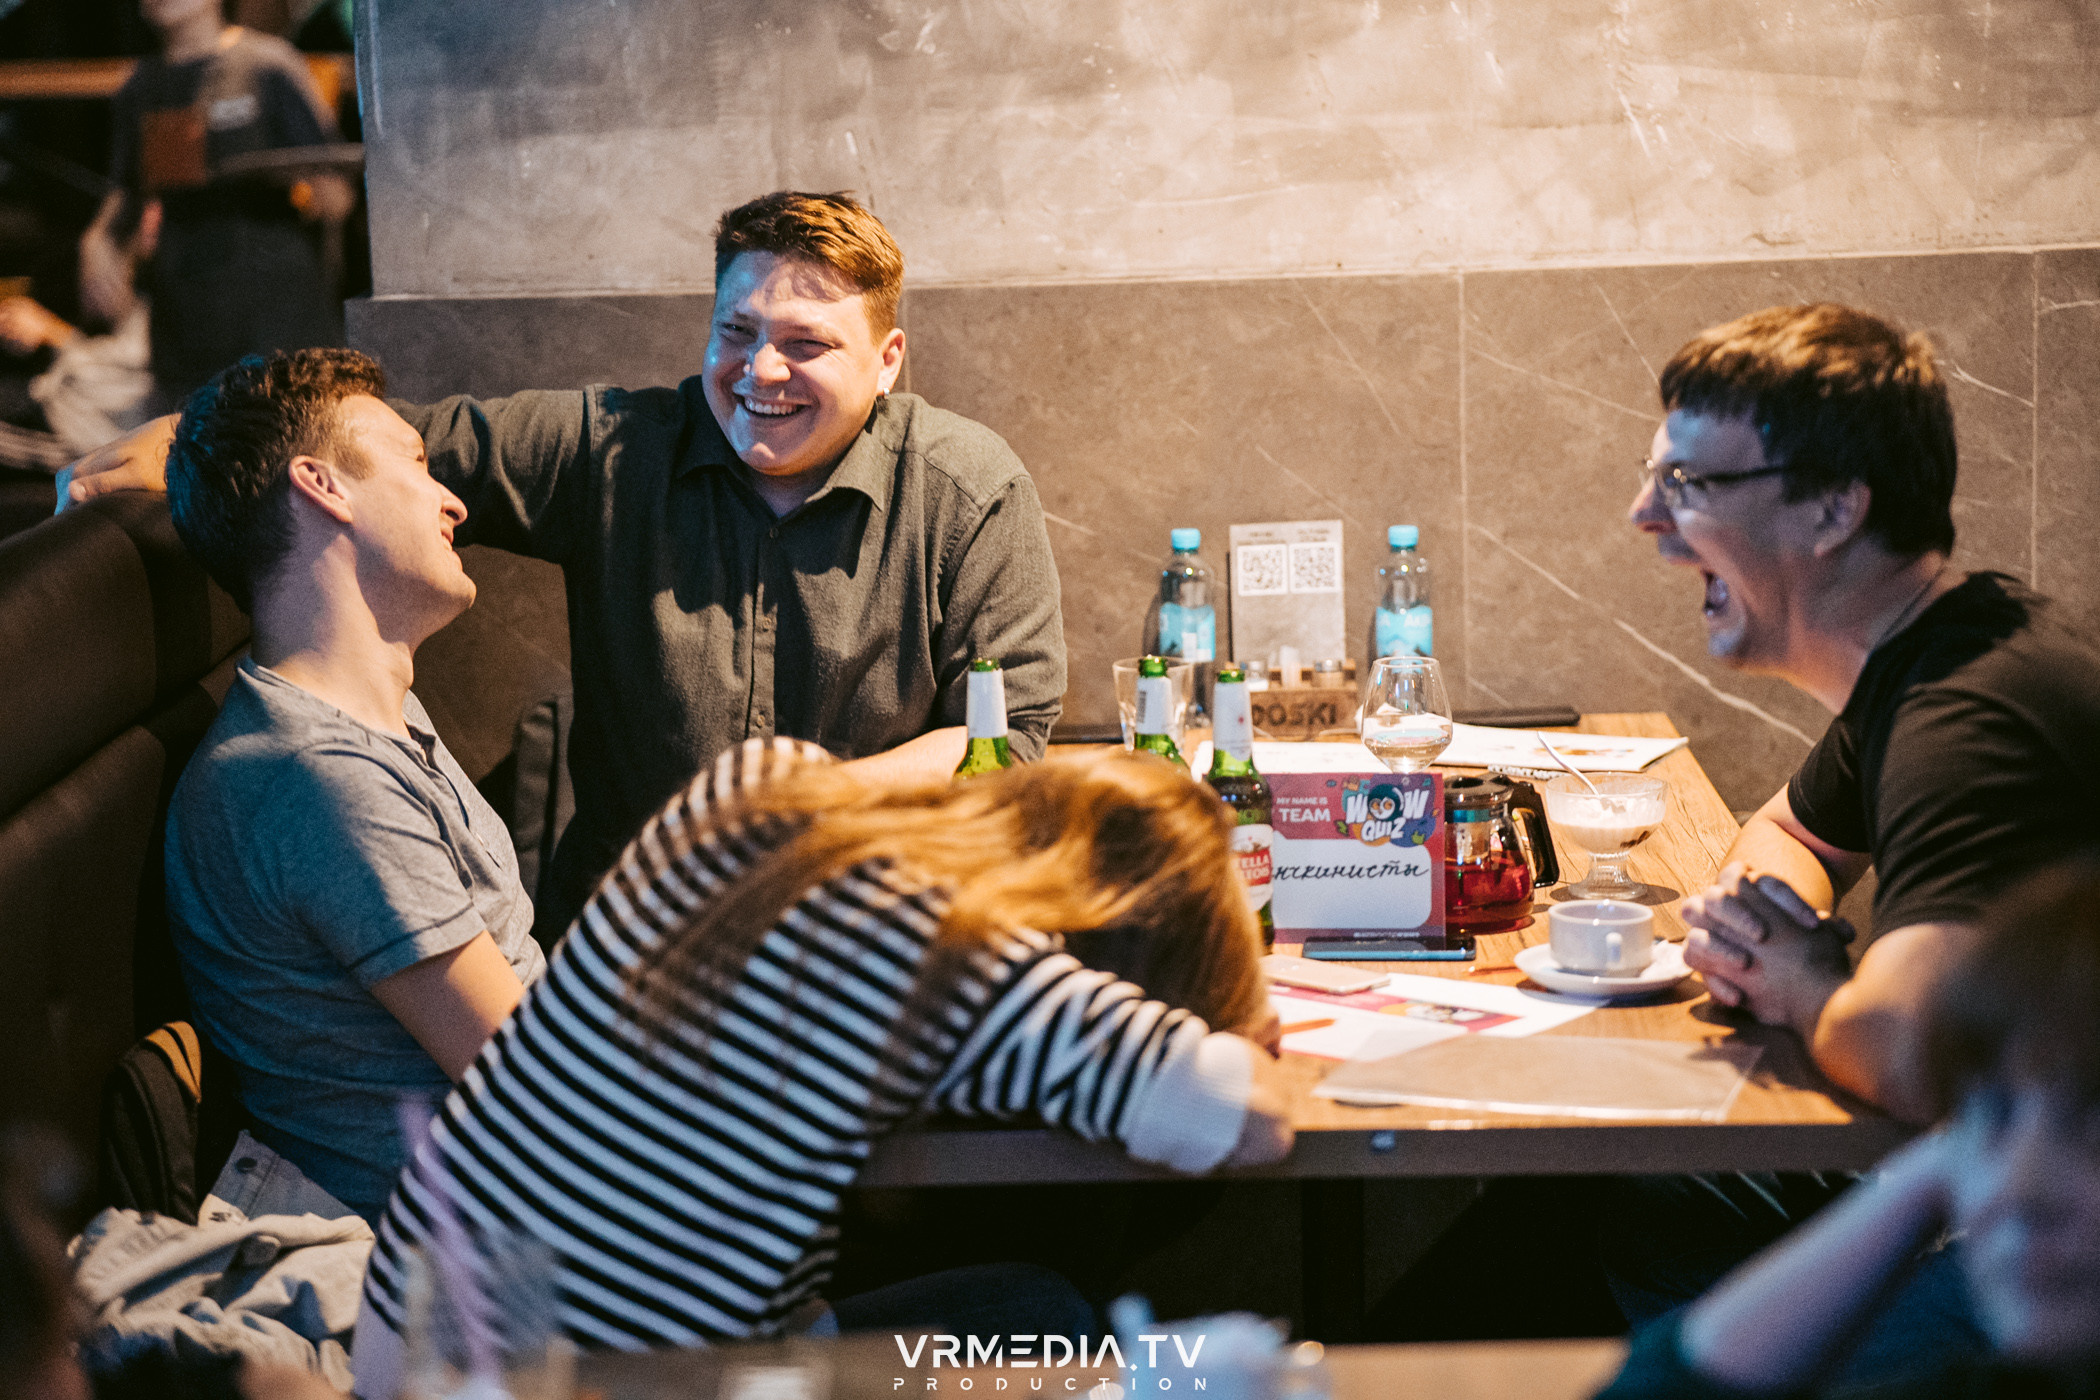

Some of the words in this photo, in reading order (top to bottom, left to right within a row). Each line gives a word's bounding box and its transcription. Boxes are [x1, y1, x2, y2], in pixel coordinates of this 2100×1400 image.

[1279, 808, 1331, 822] TEAM
[1361, 817, 1406, 842] QUIZ
[1273, 860, 1429, 880] нчкинисты
